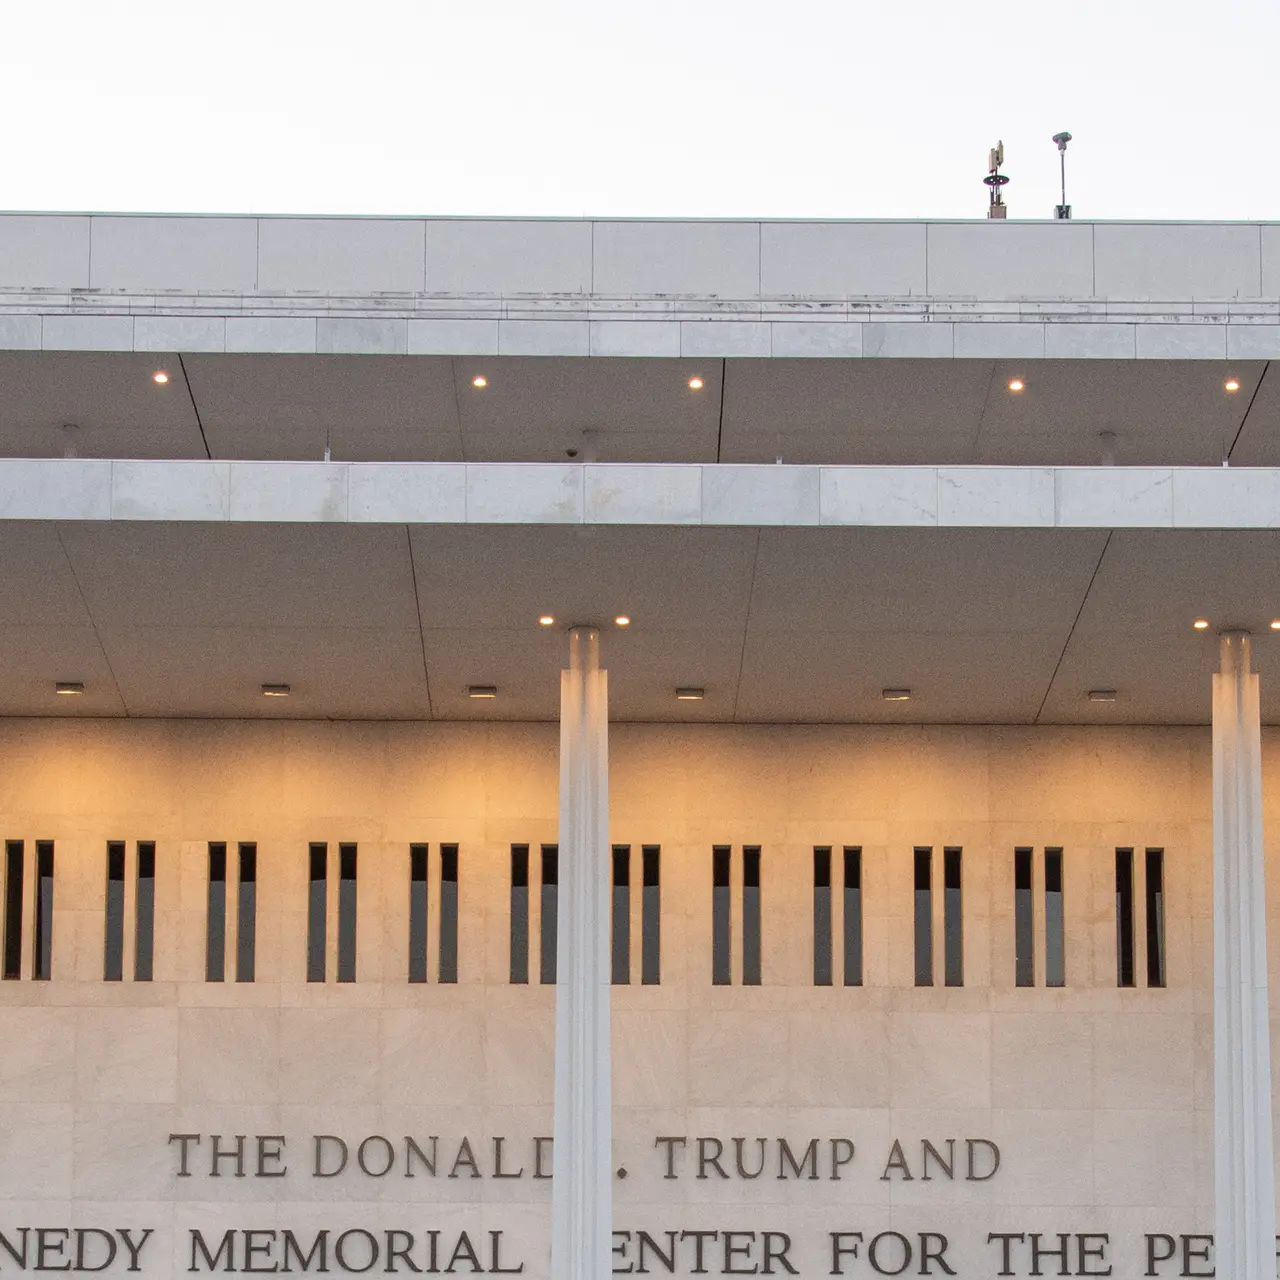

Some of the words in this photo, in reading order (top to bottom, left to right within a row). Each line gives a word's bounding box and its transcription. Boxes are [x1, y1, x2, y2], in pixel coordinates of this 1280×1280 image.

[167, 1133, 288, 1179] THE
[654, 1135, 856, 1182] TRUMP
[879, 1138, 1001, 1182] AND
[187, 1228, 524, 1275] MEMORIAL
[549, 1229, 801, 1276] ENTER
[828, 1230, 958, 1277] FOR
[986, 1231, 1113, 1277] THE
